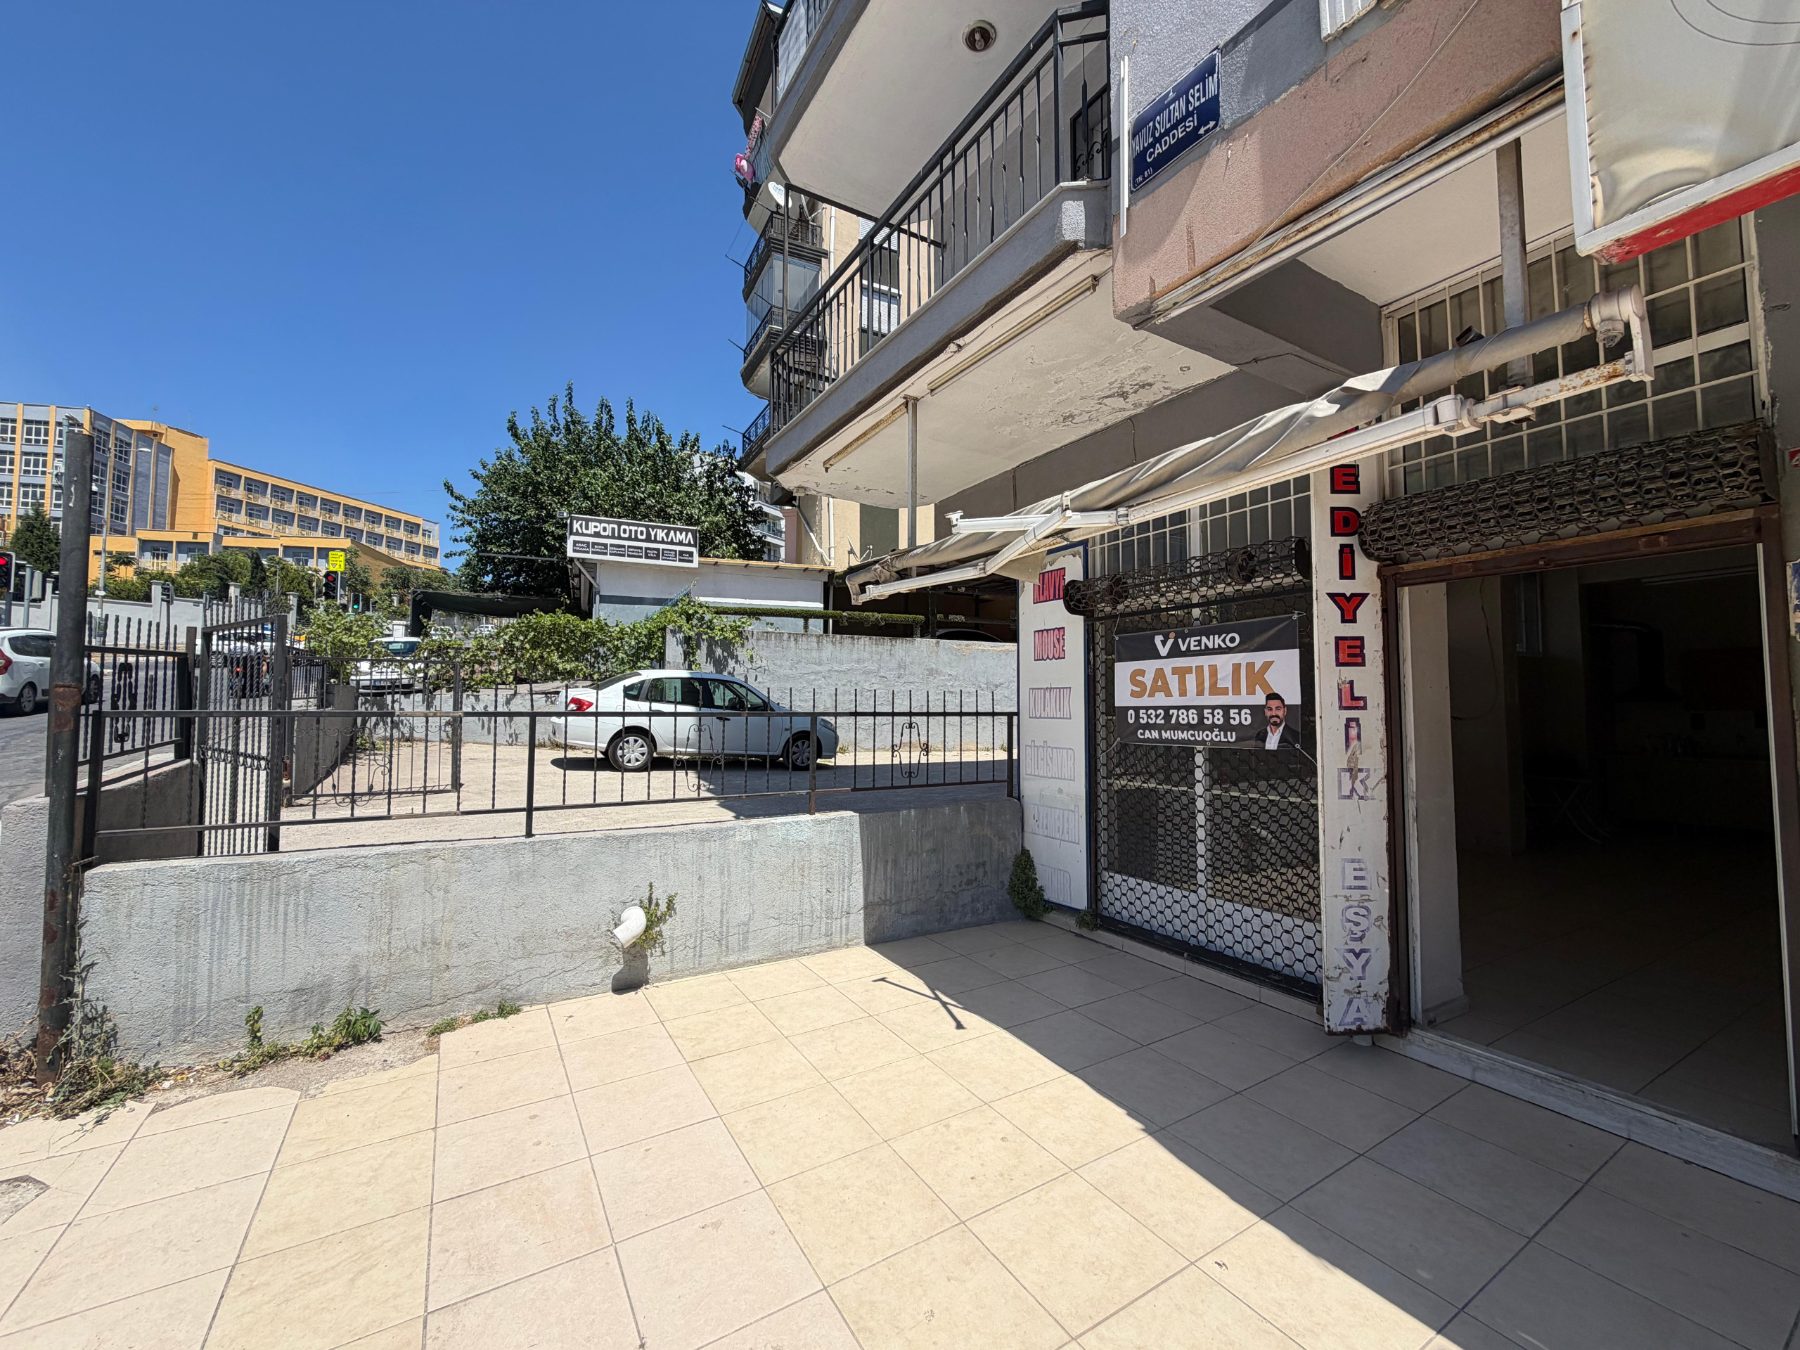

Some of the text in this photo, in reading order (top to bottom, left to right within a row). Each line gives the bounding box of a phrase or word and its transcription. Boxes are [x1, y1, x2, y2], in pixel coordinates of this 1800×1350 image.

[1132, 73, 1218, 159] YAVUZ SULTAN SELİM
[1146, 111, 1198, 163] CADDESİ
[573, 519, 694, 545] KUPON OTO YIKAMA
[1033, 626, 1066, 661] MOUSE
[1178, 632, 1240, 652] VENKO
[1129, 660, 1276, 699] SATILIK
[1029, 687, 1072, 720] KULAKLIK
[1127, 709, 1252, 725] 0 532 786 58 56
[1137, 728, 1237, 742] CAN MUMCUOĞLU
